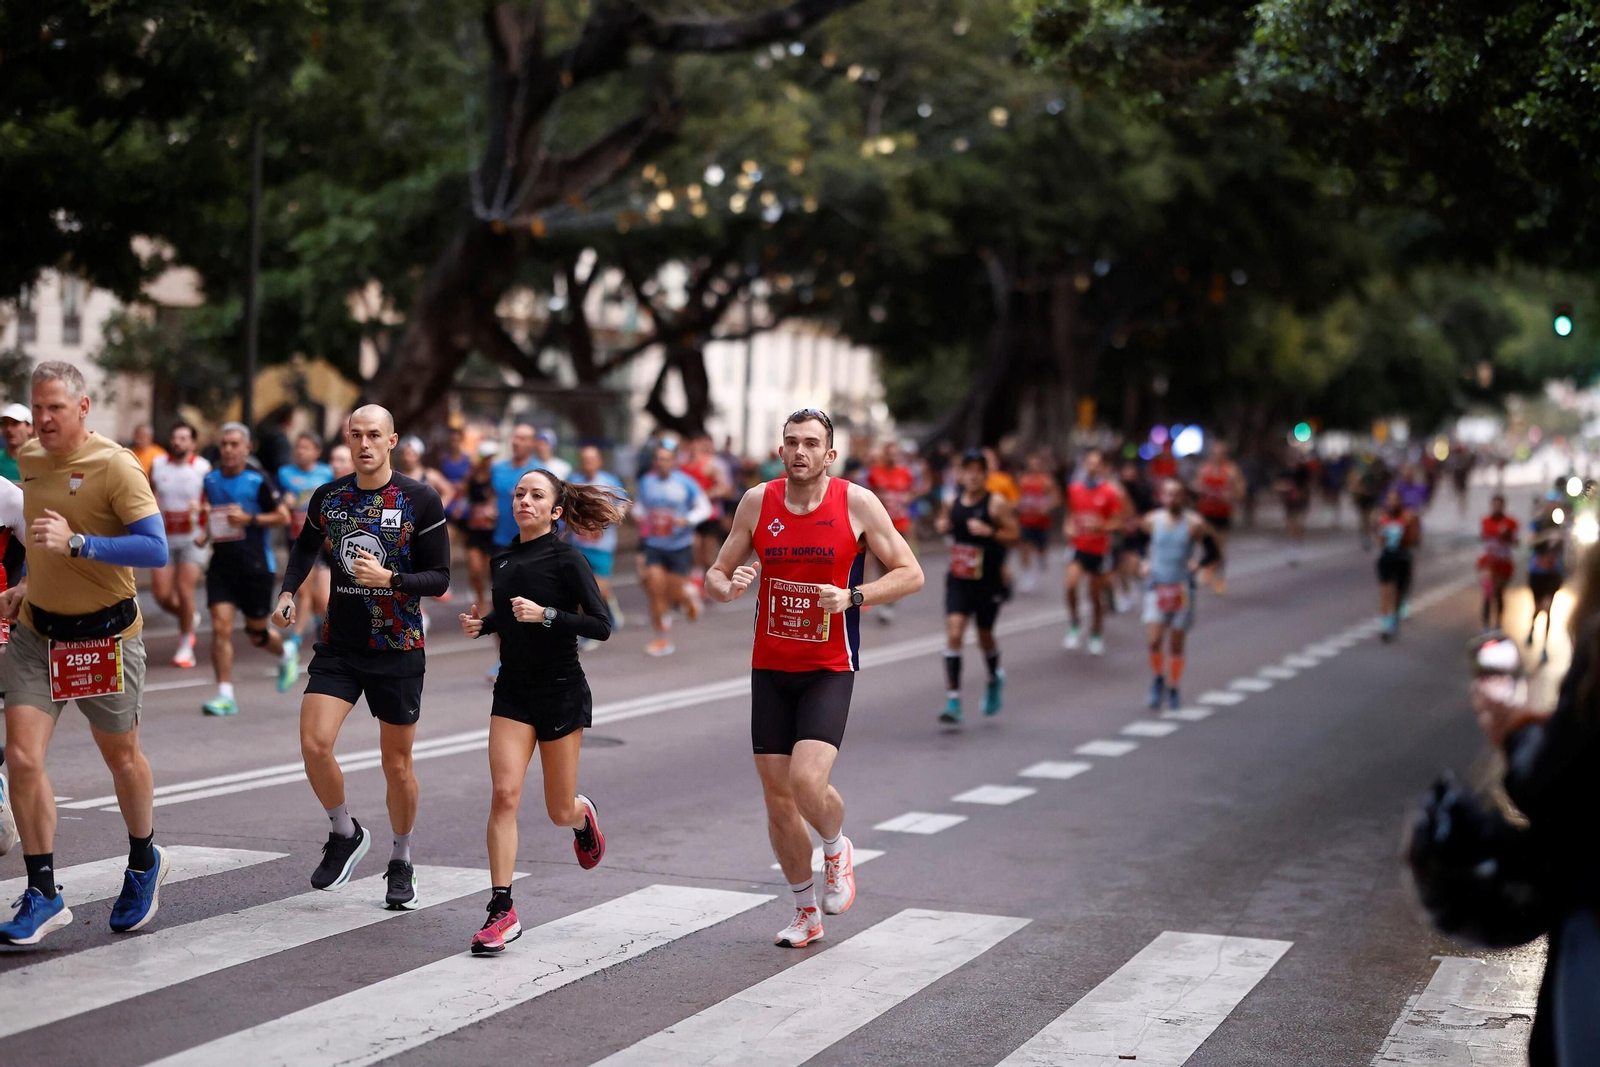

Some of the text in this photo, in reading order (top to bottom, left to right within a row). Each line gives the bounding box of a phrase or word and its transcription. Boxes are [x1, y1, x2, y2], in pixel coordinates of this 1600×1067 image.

[382, 518, 397, 526] AXA
[765, 547, 834, 556] WEST NORFOLK
[336, 586, 370, 595] MADRID
[783, 584, 821, 594] GENERAL
[781, 596, 810, 608] 3128
[67, 638, 110, 649] GENERALI
[66, 653, 100, 666] 2592
